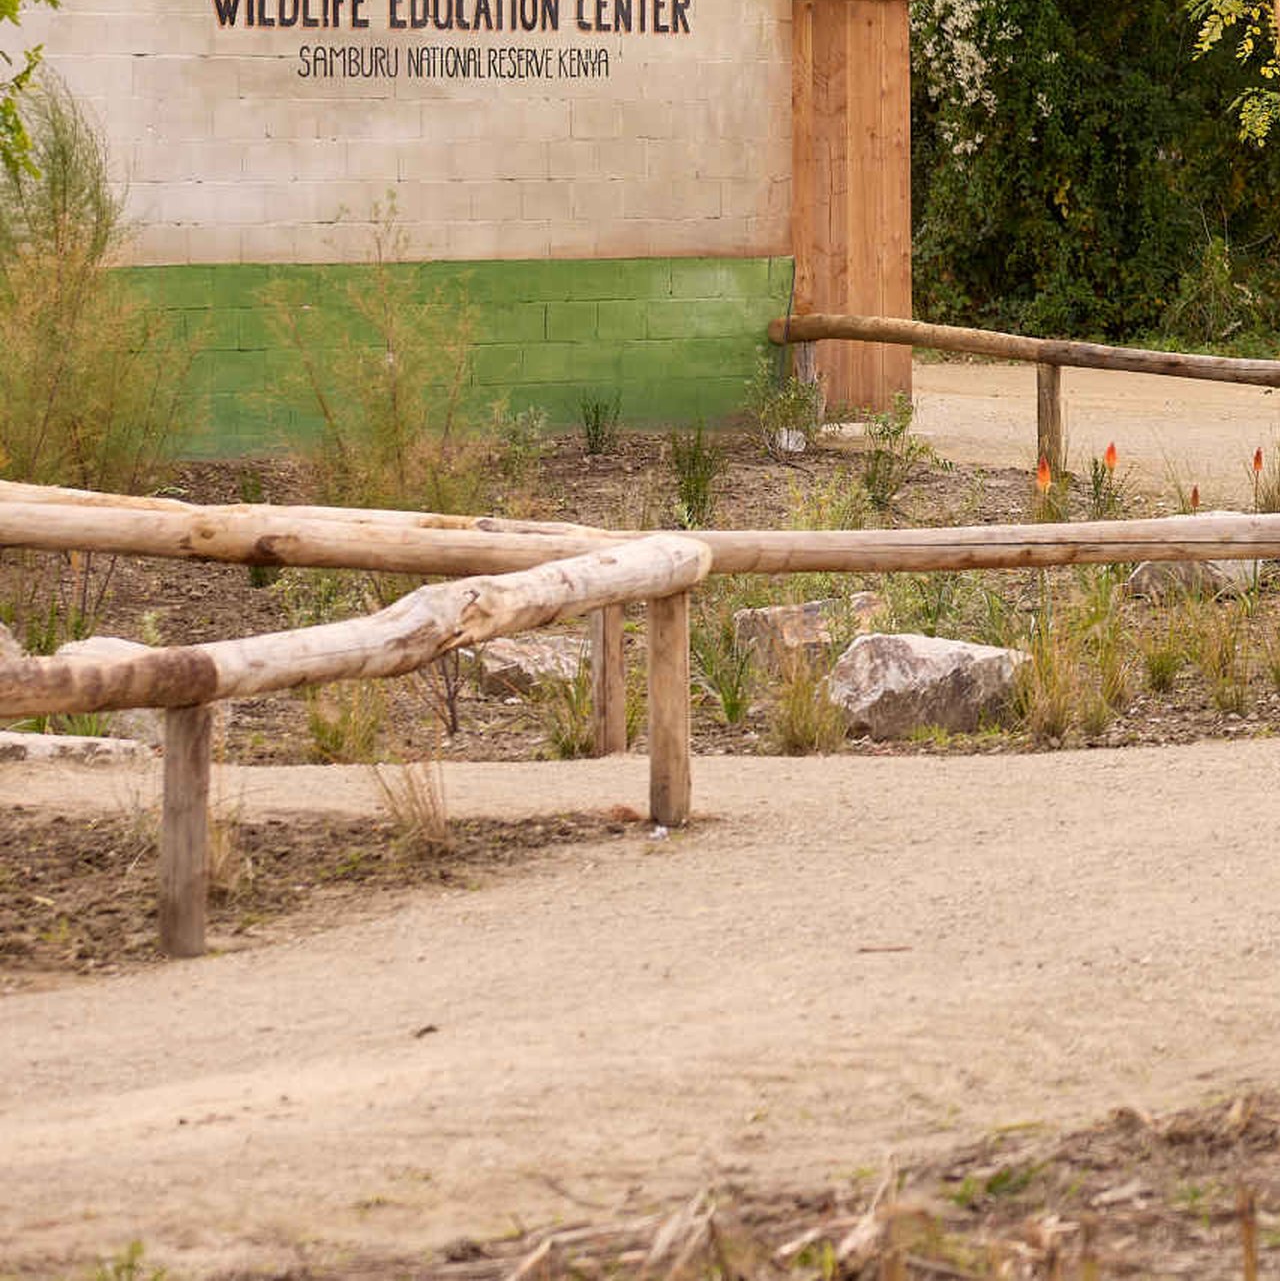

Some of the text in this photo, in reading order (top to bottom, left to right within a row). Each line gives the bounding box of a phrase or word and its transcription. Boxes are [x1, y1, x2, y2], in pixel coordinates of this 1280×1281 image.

[297, 45, 609, 79] SAMBURU NATIONAL RESERVE KENYA
